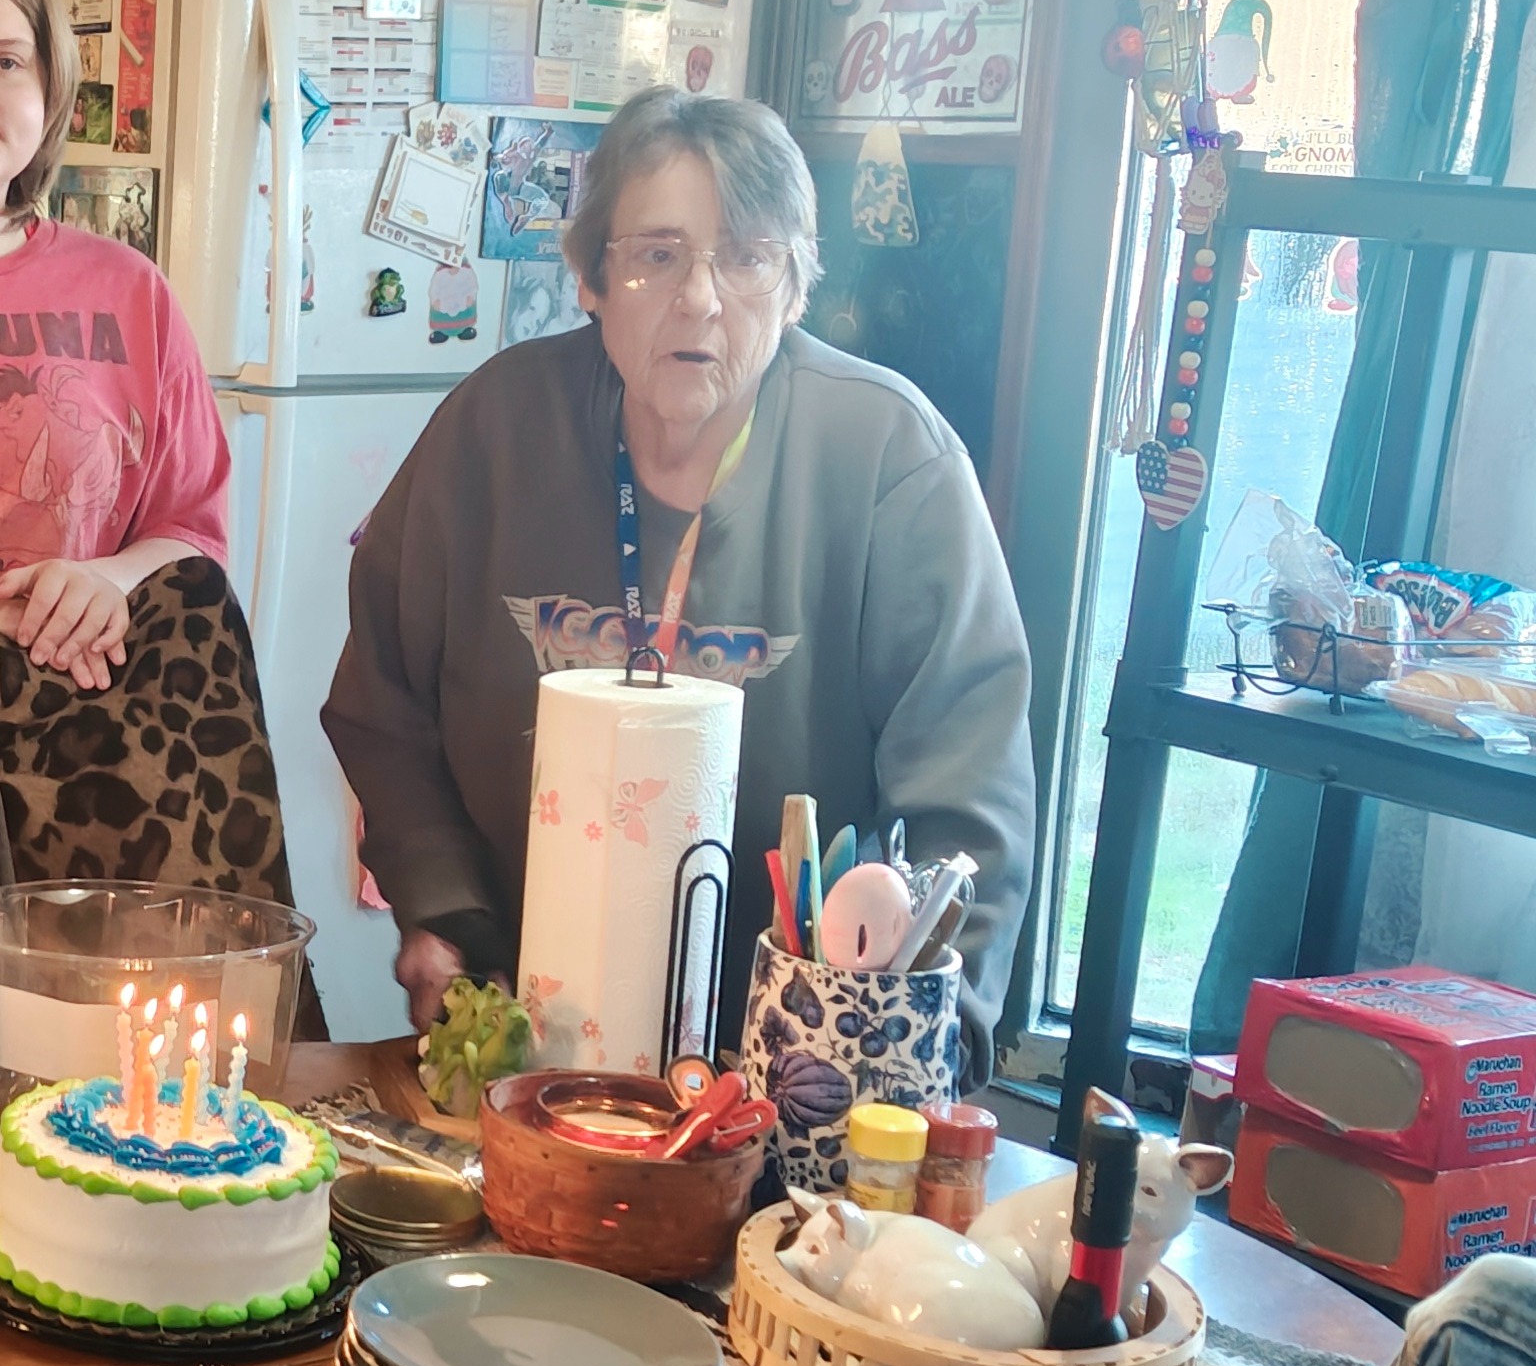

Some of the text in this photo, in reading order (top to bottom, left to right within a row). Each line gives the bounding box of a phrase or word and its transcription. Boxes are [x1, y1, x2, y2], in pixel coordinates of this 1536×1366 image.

[832, 4, 981, 104] Bass
[934, 86, 977, 109] ALE
[1294, 146, 1355, 163] GNOM
[1475, 1055, 1522, 1072] Maruchan
[1478, 1081, 1518, 1097] Ramen
[1462, 1096, 1532, 1115] Noodle Soup
[1489, 1120, 1520, 1134] Flavor
[1458, 1205, 1508, 1224] Maruchan
[1463, 1230, 1504, 1248] Ramen
